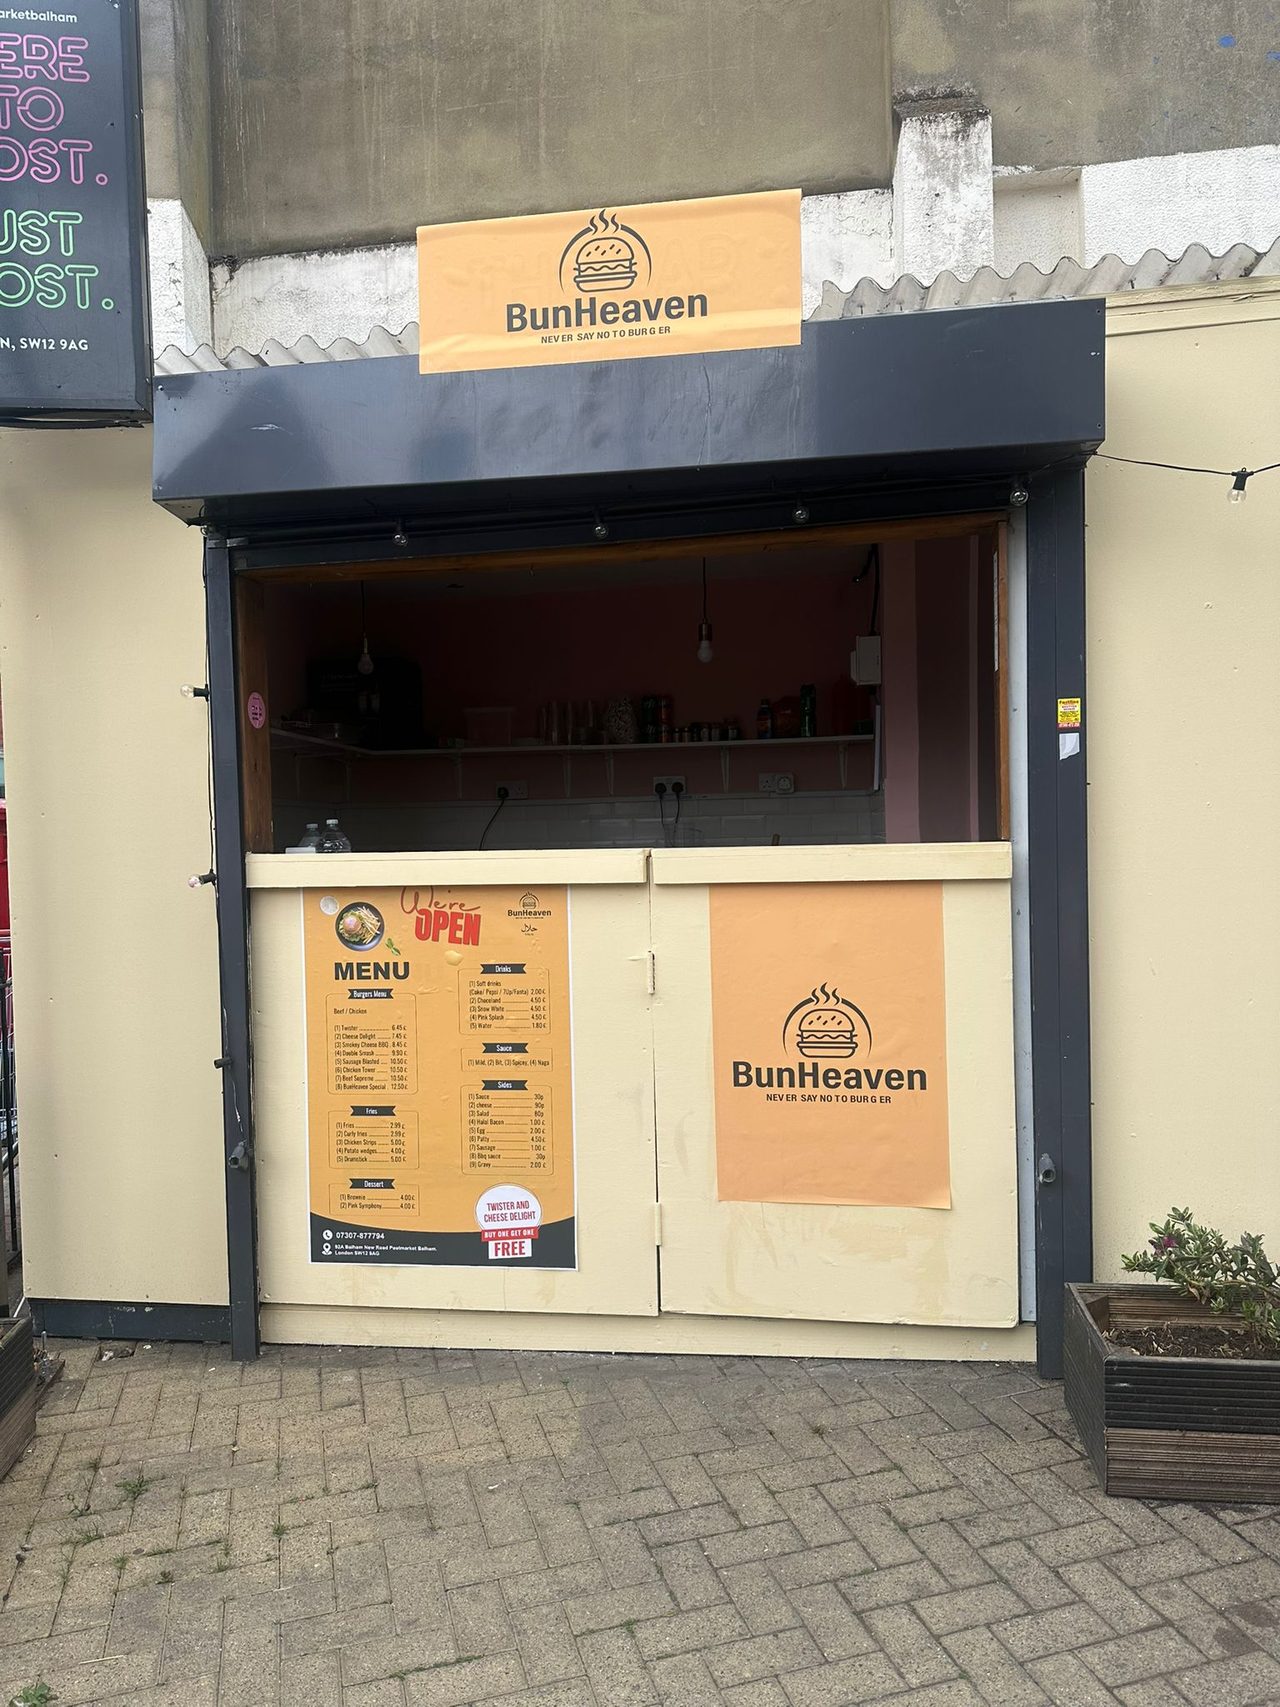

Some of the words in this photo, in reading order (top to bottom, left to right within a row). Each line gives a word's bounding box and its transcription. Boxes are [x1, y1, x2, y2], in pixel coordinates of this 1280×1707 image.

[0, 8, 78, 23] arketbalham
[506, 294, 708, 333] BunHeaven
[541, 333, 574, 344] NEVER
[576, 332, 595, 341] SAY
[596, 331, 610, 339] NO
[612, 329, 626, 338] TO
[628, 326, 671, 337] BURGER
[20, 337, 55, 350] SW12
[60, 339, 89, 351] 9AG
[414, 908, 481, 946] OPEN
[334, 962, 409, 980] MENU
[353, 990, 373, 998] Burgers
[373, 990, 387, 998] Menu
[732, 1060, 927, 1091] BunHeaven
[766, 1094, 798, 1102] NEVER
[800, 1094, 818, 1102] SAY
[819, 1094, 833, 1103] NO
[835, 1095, 848, 1103] TO
[850, 1095, 892, 1104] BURGER
[487, 1202, 515, 1212] TWISTER
[516, 1200, 530, 1209] AND
[484, 1212, 508, 1223] CHEESE
[509, 1211, 536, 1221] DELIGHT
[494, 1241, 526, 1256] FREE
